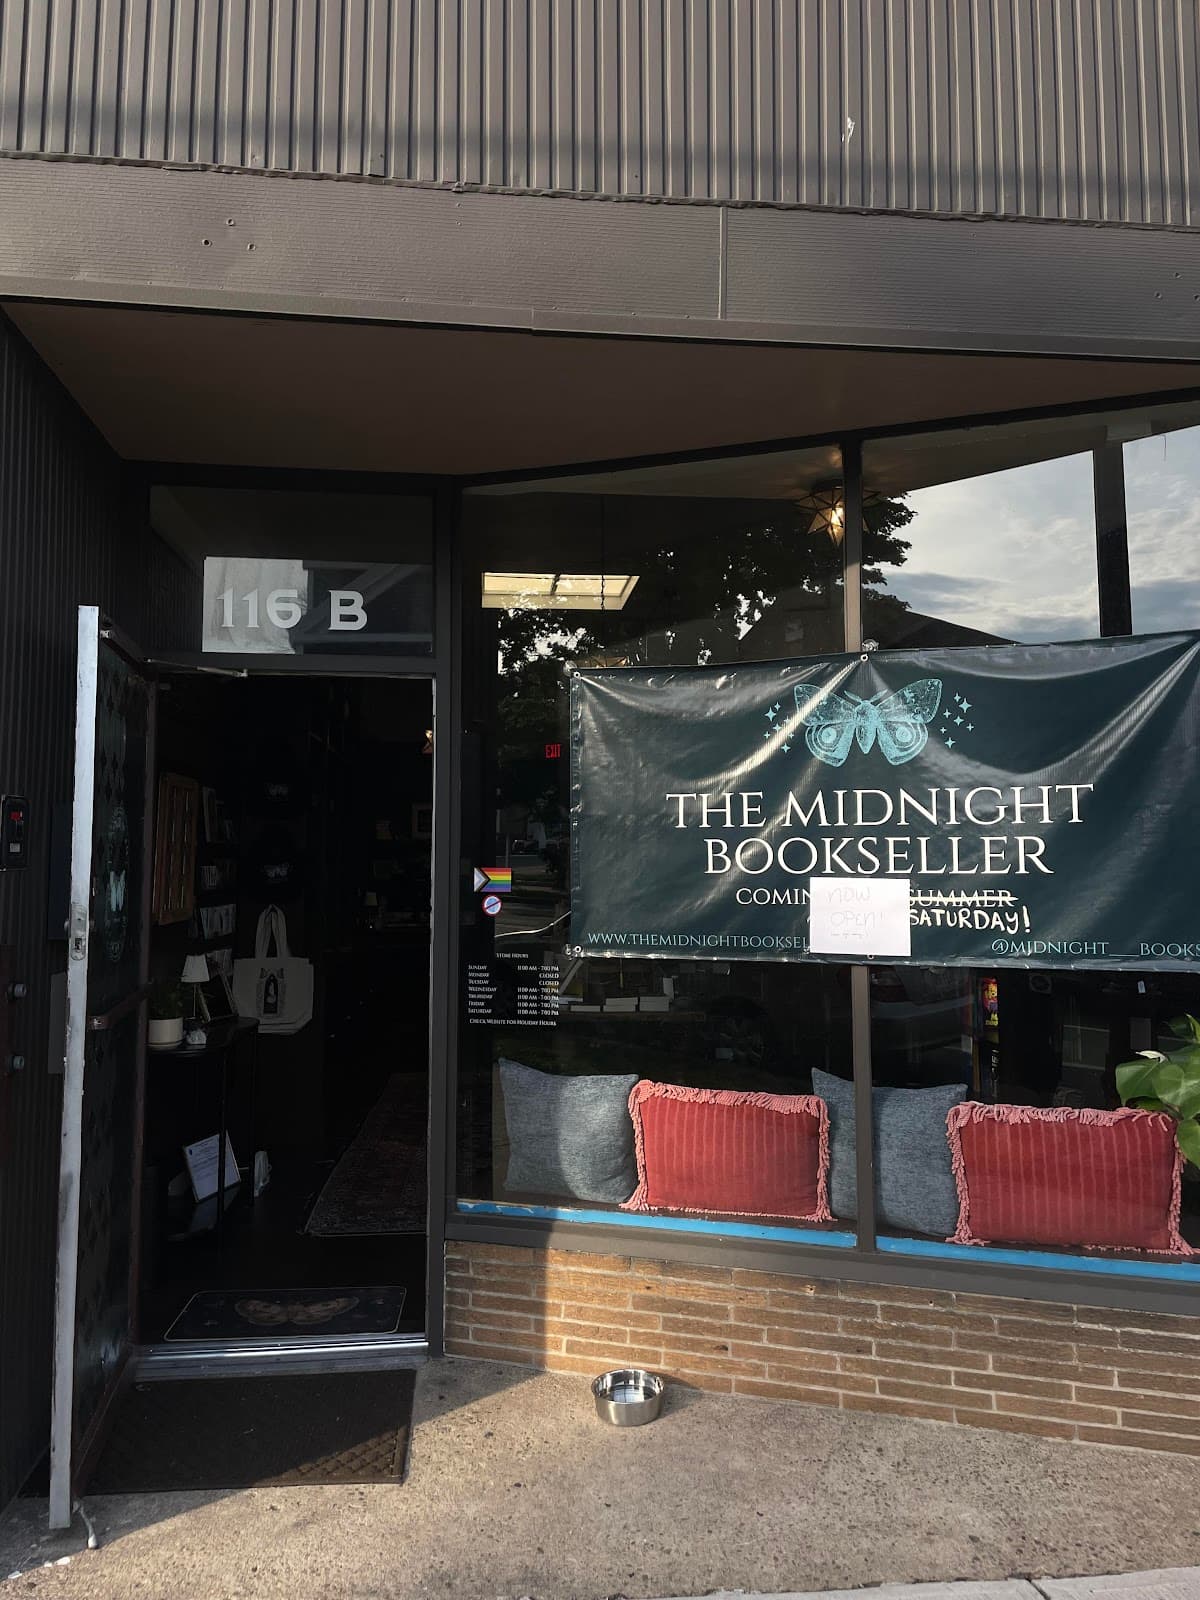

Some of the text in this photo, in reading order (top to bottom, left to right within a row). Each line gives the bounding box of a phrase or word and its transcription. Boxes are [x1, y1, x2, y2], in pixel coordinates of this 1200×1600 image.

[216, 587, 368, 631] 116 B
[545, 743, 561, 759] EXIT
[666, 783, 1094, 829] THE MIDNIGHT
[704, 835, 1055, 876] BOOKSELLER
